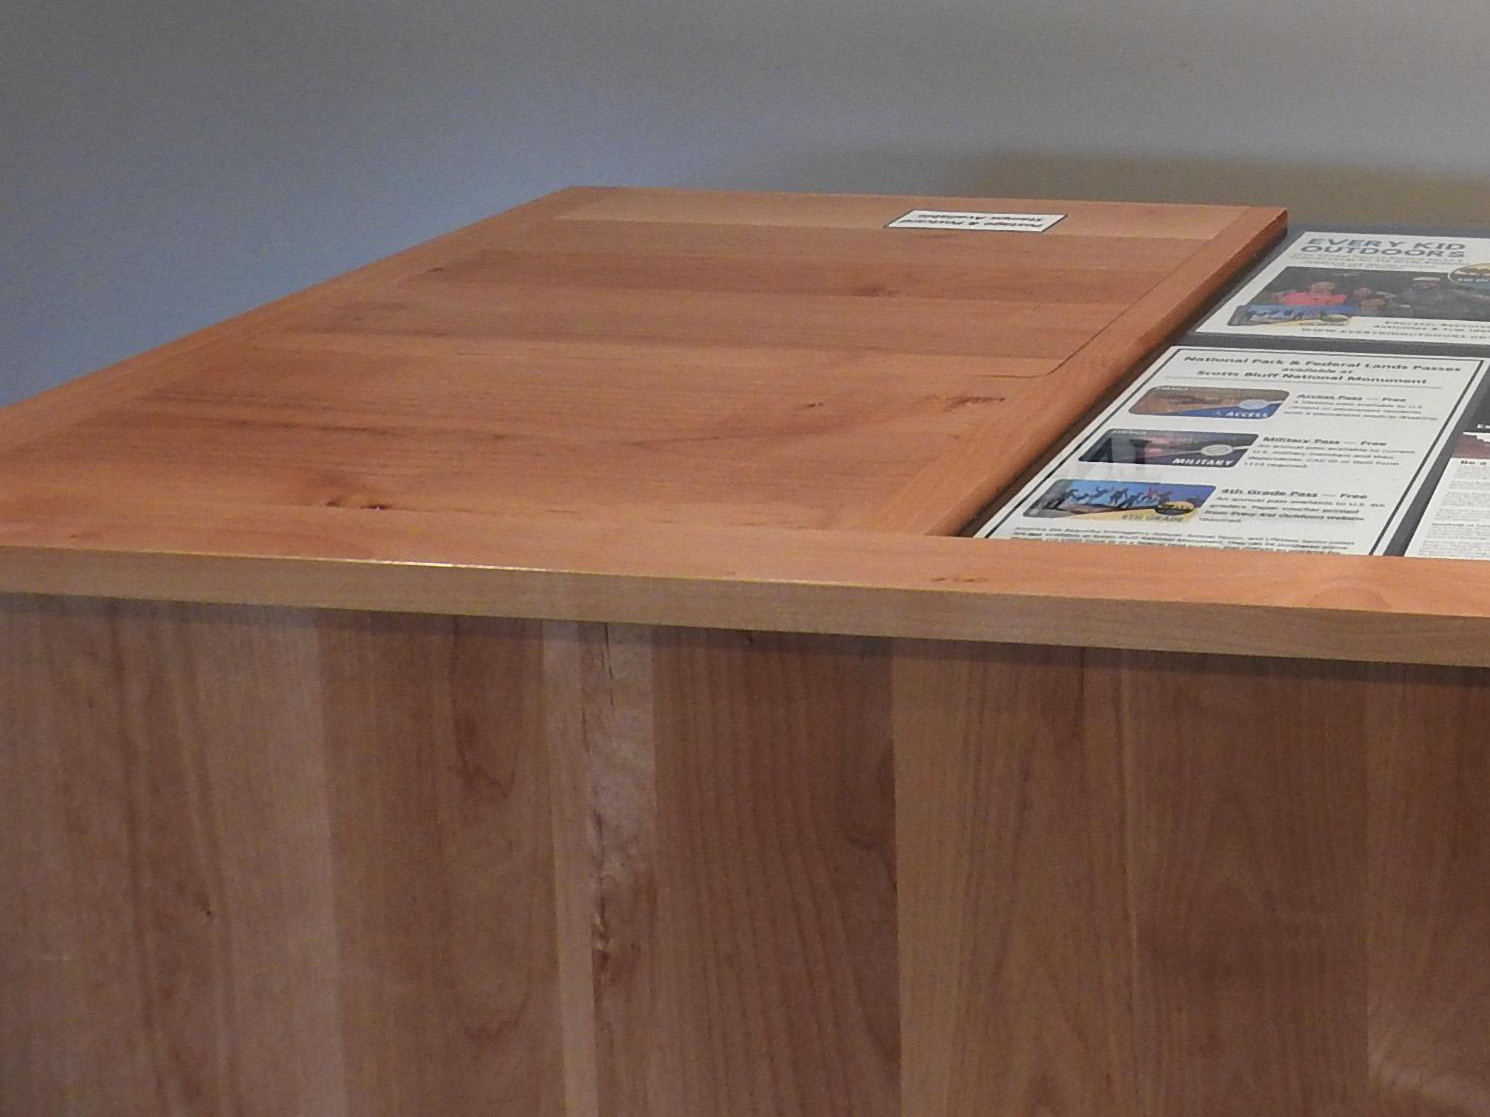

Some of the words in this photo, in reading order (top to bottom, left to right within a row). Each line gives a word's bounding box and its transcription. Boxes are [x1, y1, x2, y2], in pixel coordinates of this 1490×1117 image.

[1307, 238, 1405, 247] EVERY
[1414, 242, 1466, 250] KID
[1301, 245, 1465, 258] OUTDOORS
[1184, 356, 1248, 364] National
[1282, 373, 1343, 381] National
[1347, 375, 1427, 384] Monument
[1263, 436, 1310, 444] Military
[1172, 458, 1233, 466] MILITARY
[1290, 490, 1318, 498] Pass
